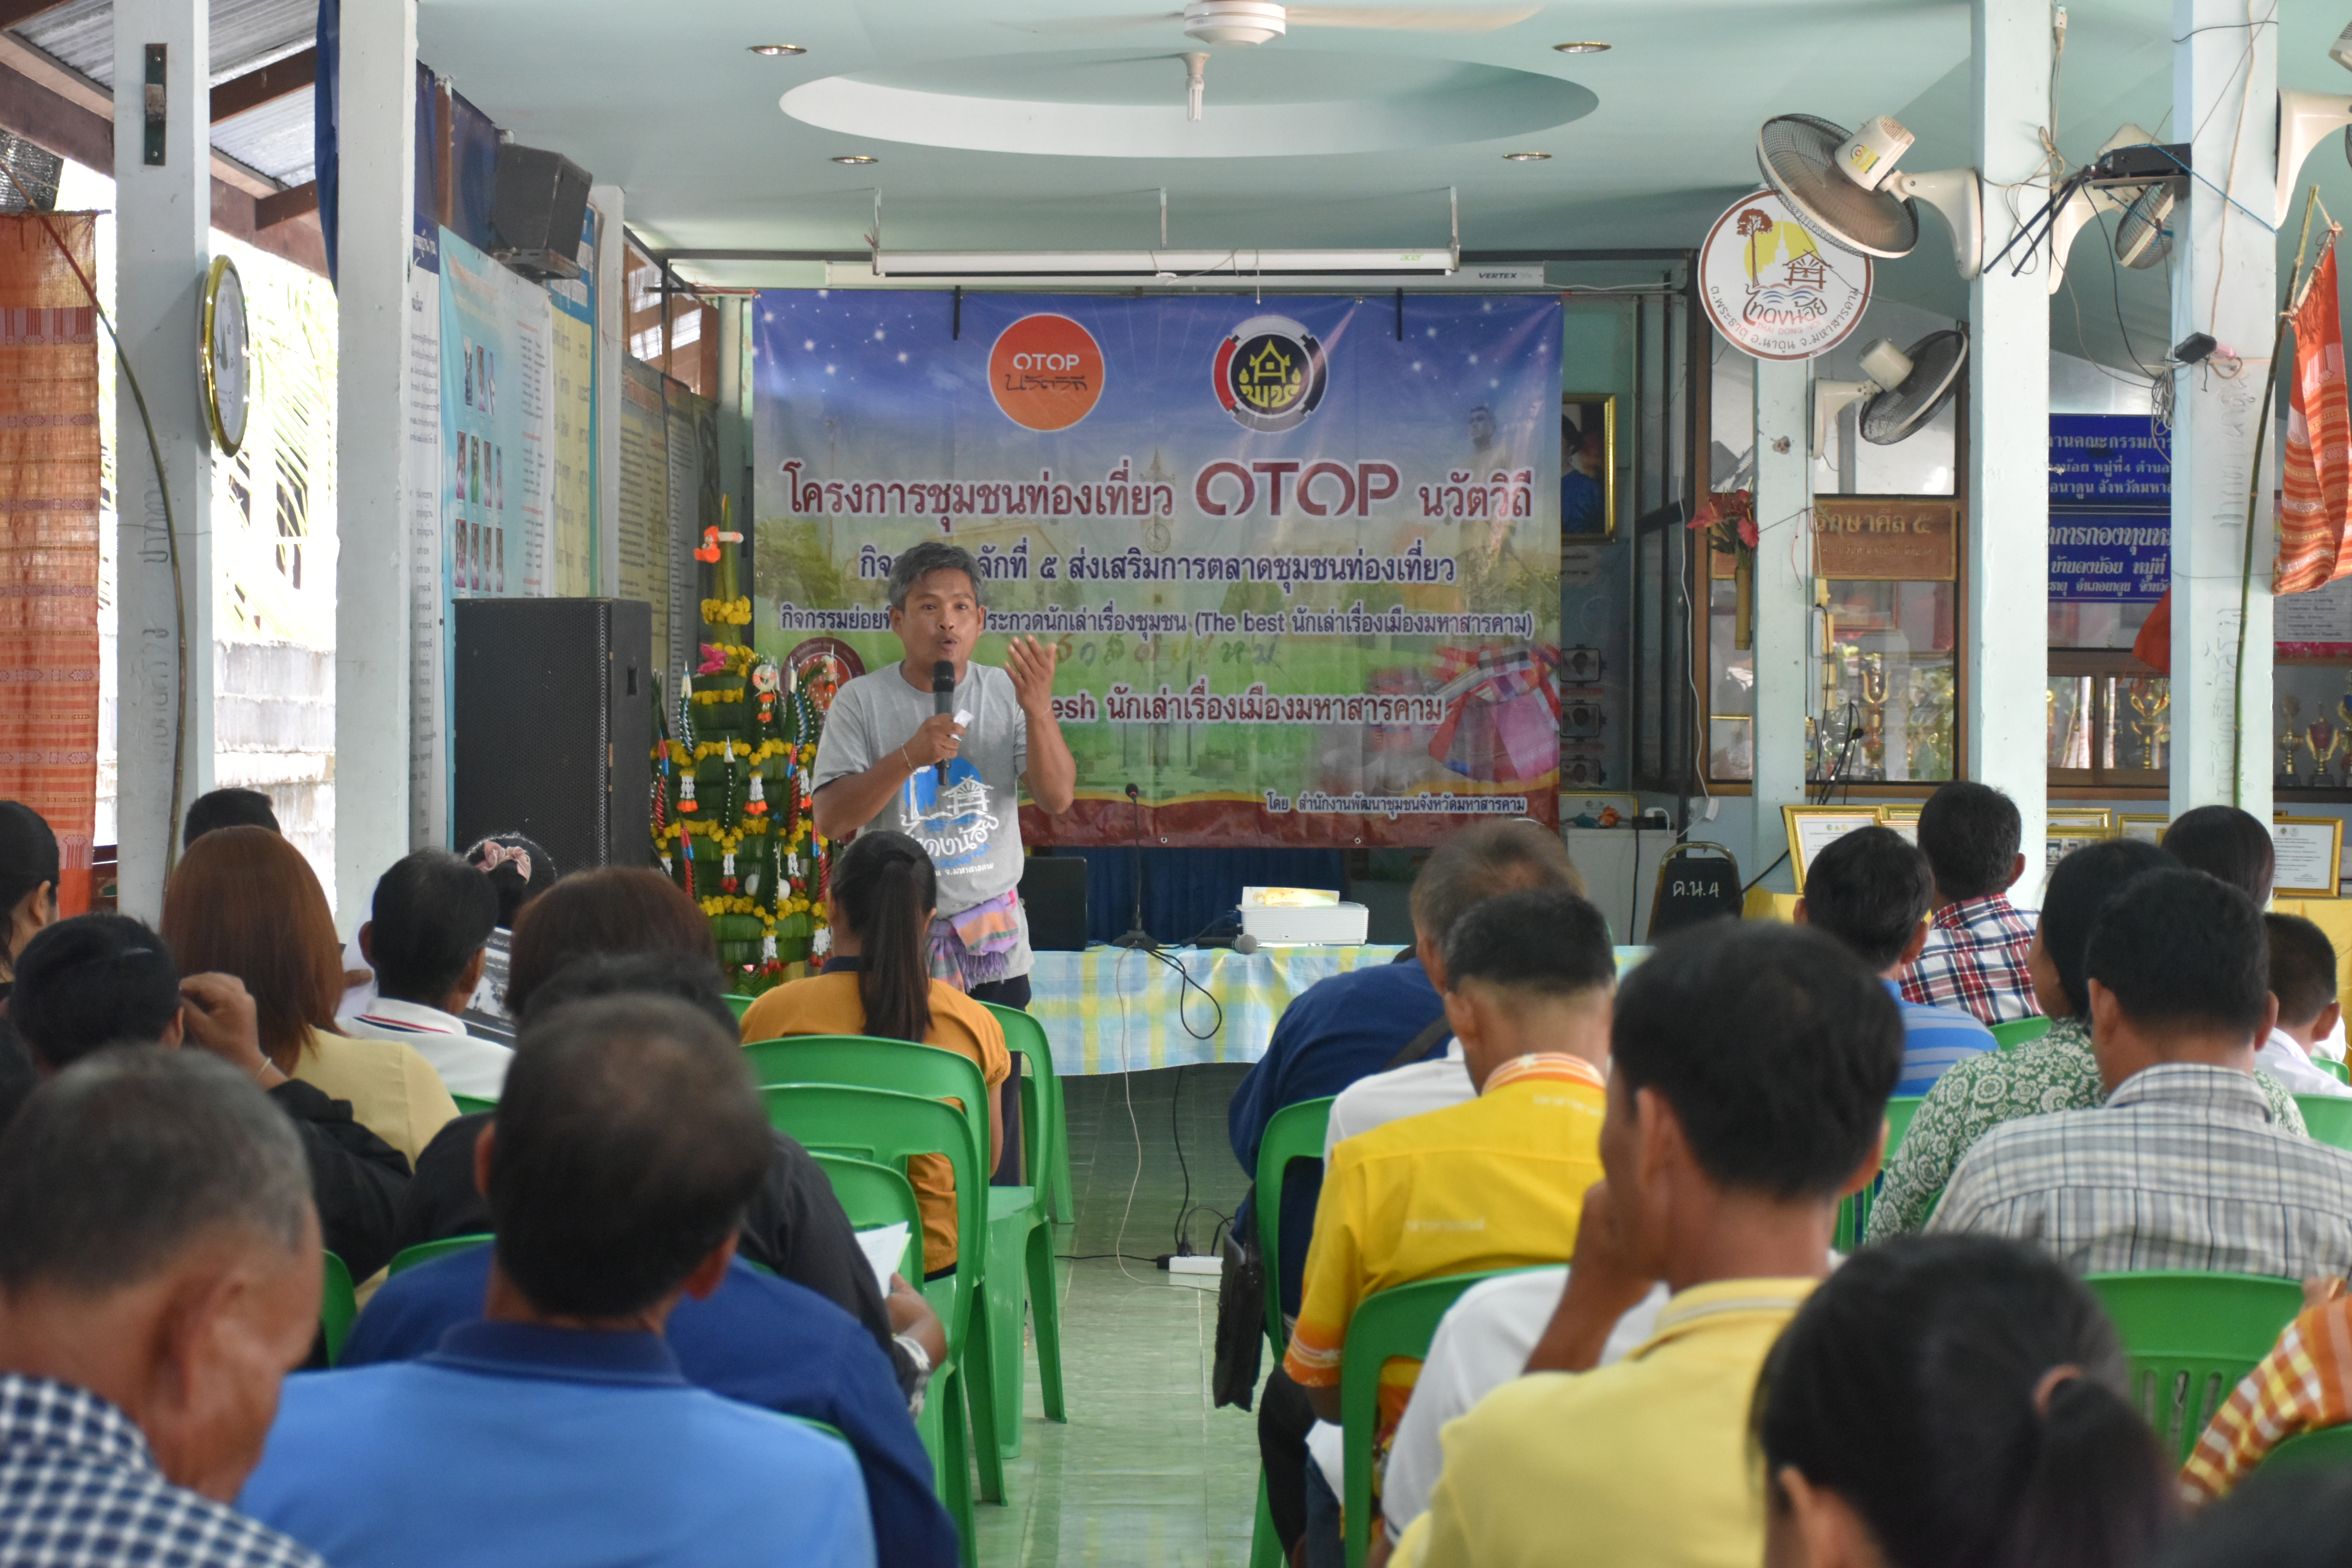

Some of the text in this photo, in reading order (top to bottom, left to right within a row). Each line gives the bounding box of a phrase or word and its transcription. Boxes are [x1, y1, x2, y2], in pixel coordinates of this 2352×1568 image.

[1743, 283, 1828, 326] ไทดงน้อย
[1751, 334, 1796, 353] อ.นาดูน
[1756, 322, 1775, 334] THAI
[1808, 320, 1822, 331] NOI
[1013, 353, 1080, 371] OTOP
[783, 459, 1532, 532] โครงการชุมชนท่องเที่ยว OTOP นวัตวิถี
[1040, 556, 1057, 579] ๕
[1069, 540, 1454, 593] ส่งเสริมการตลาดชุมชนท่องเที่ยว
[983, 601, 1187, 641] ระกวดนักเล่าเรื่องชุมชน
[1196, 612, 1236, 635] (The
[1244, 612, 1284, 632] best
[1292, 602, 1533, 637] นักเล่าเรื่องเมืองมหาสารคาม)
[1052, 679, 1442, 721] esh นักเล่าเรื่องเมืองมหาสารคาม
[1267, 791, 1525, 816] โดย สำนักงานพัฒนาชุมชนจังหวัดมหาสารคาม
